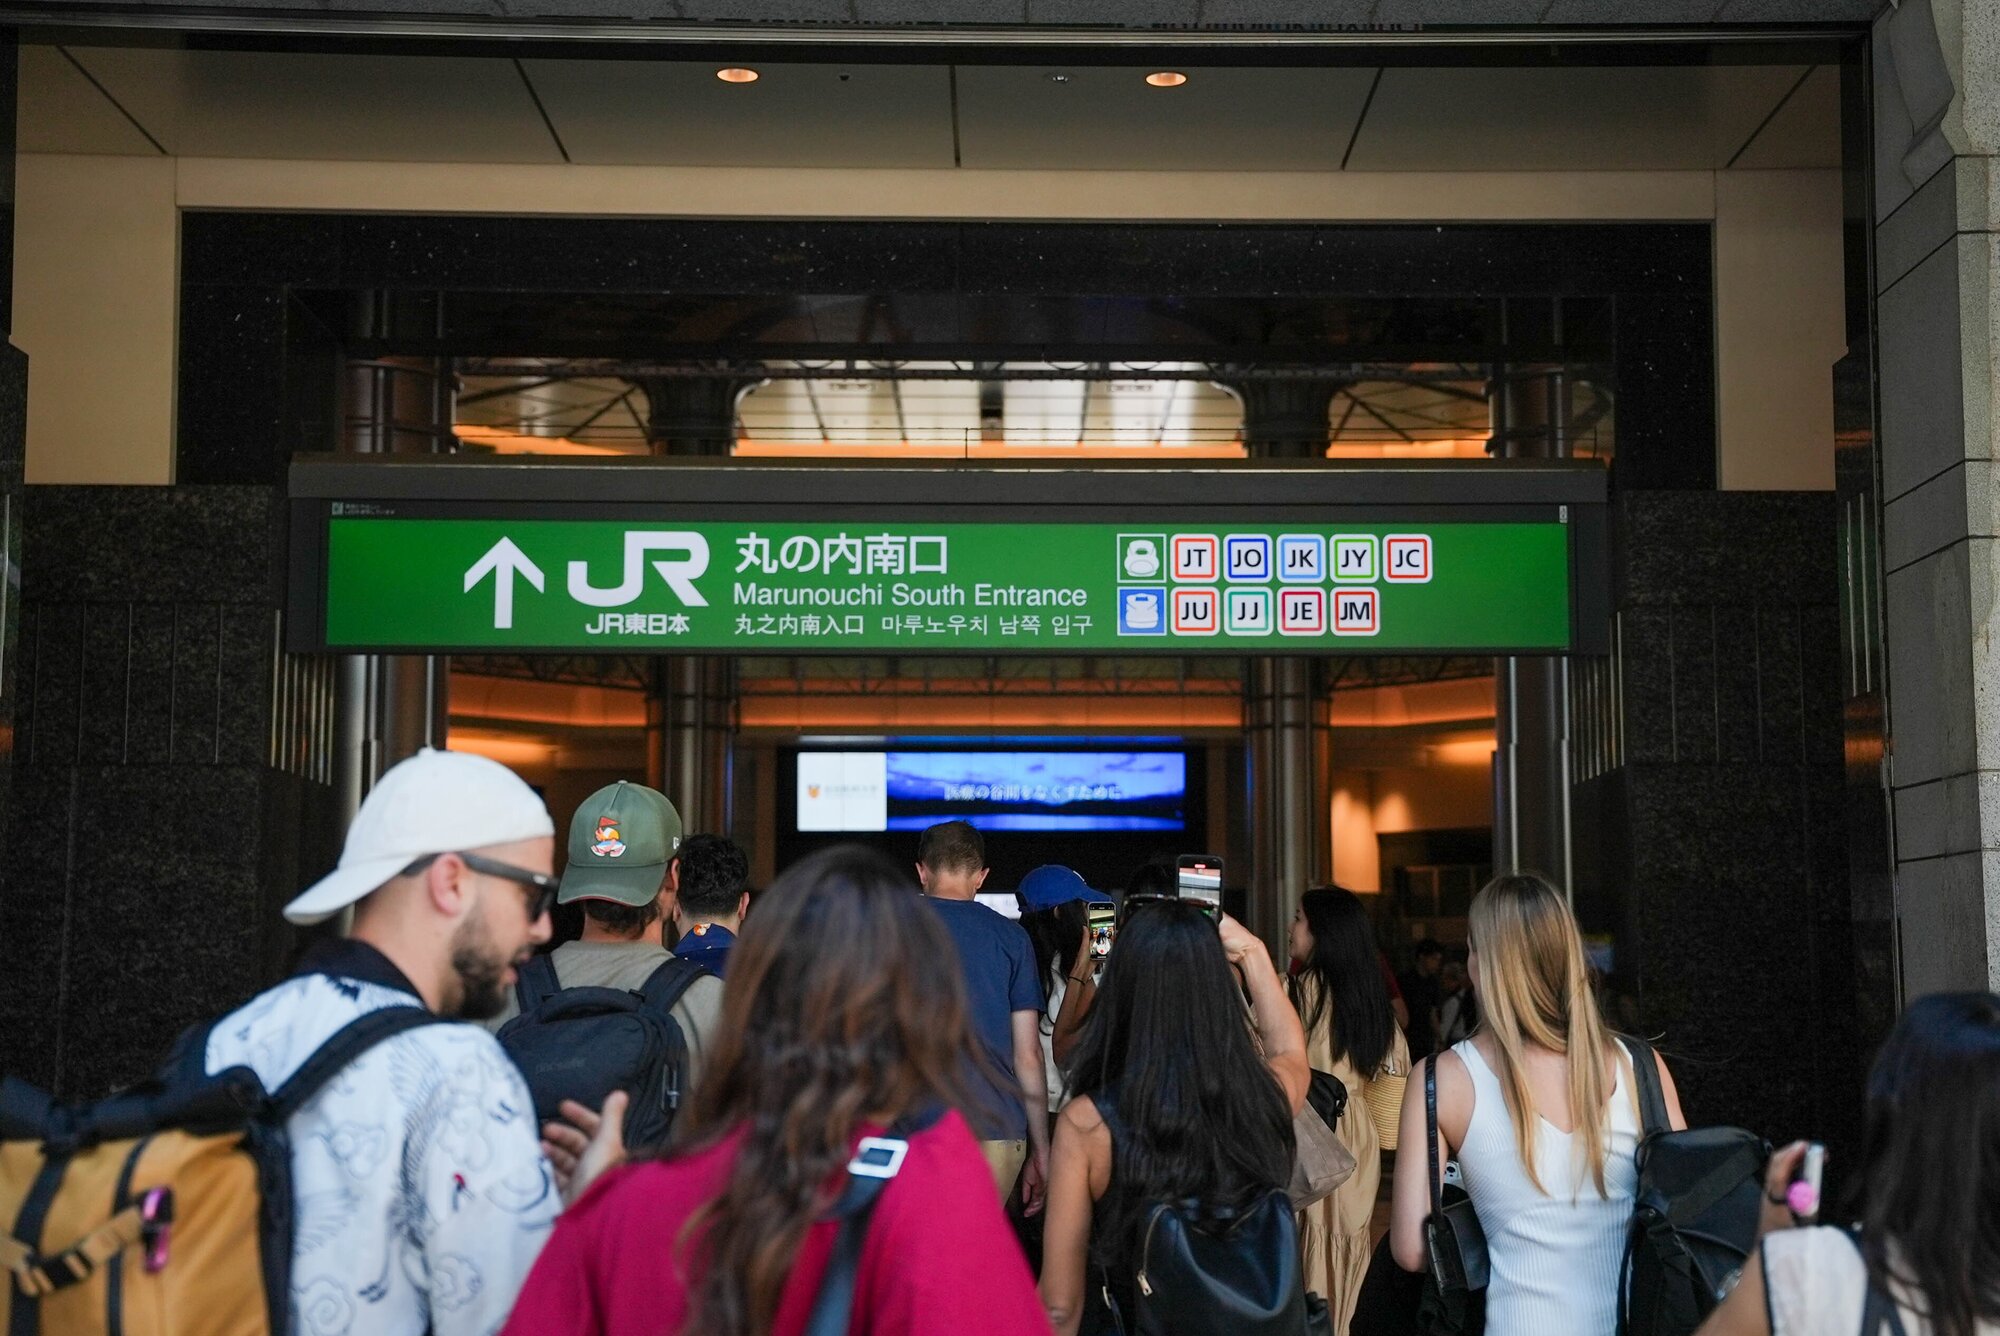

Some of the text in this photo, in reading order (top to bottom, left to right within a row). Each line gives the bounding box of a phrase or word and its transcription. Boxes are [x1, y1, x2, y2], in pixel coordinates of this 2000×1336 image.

[735, 532, 948, 575] 丸の内南口
[1183, 549, 1420, 568] JT JO JK JY JC
[567, 531, 710, 607] JR
[733, 582, 1088, 606] Marunouchi South Entrance
[1181, 602, 1370, 620] JU JJ JE JM
[585, 613, 690, 635] JR東日本
[734, 613, 864, 635] 丸之内南入口
[881, 614, 1093, 635] 마루노우치 남쪽 입구
